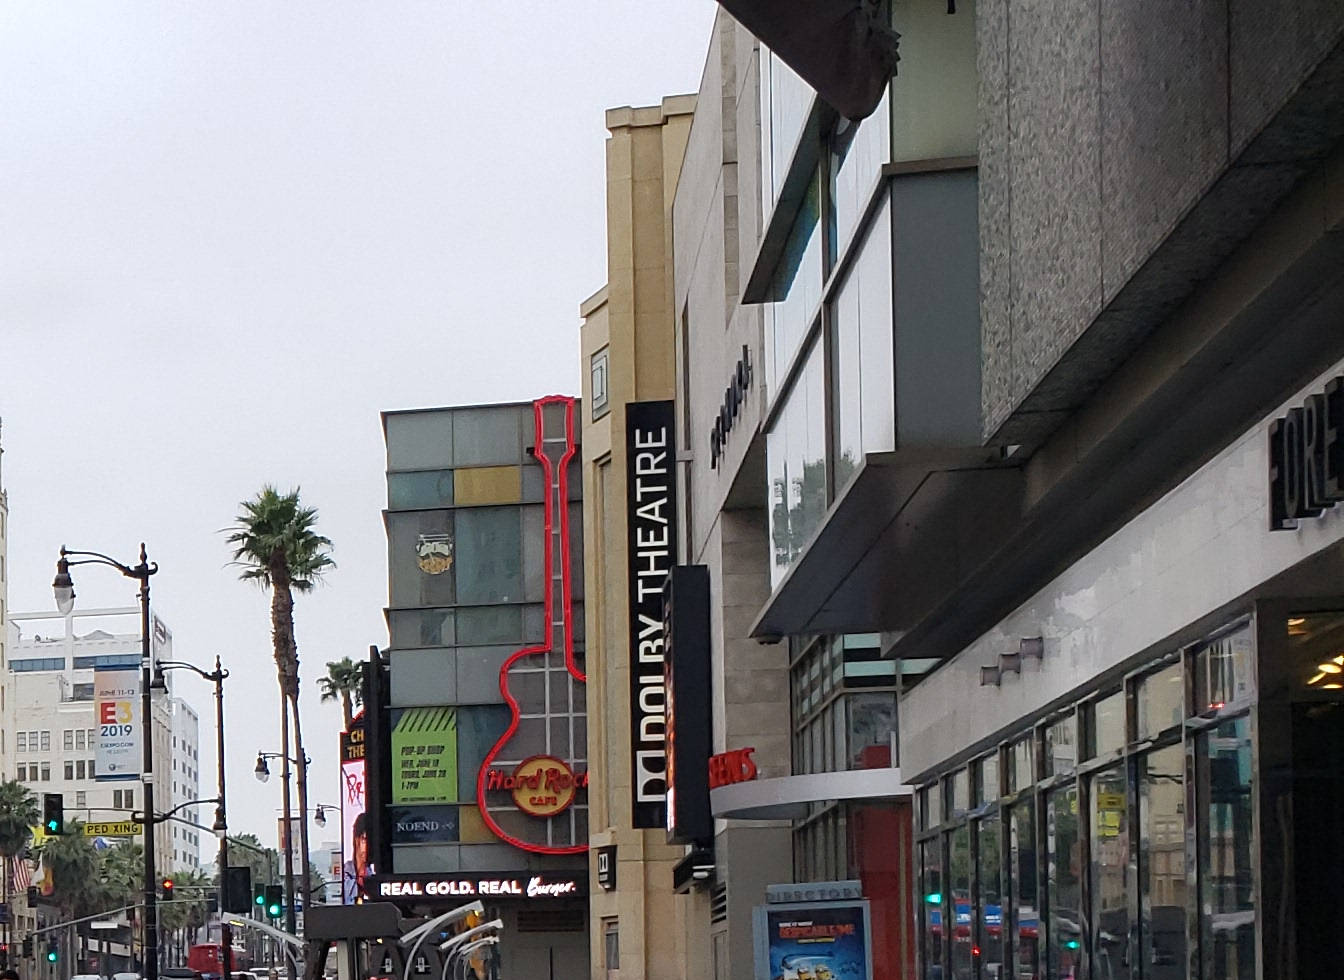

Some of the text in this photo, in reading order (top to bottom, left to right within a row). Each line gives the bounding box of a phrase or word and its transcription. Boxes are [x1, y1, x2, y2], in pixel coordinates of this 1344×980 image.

[636, 428, 668, 603] THEATRE
[101, 702, 133, 724] E3
[100, 725, 132, 737] 2019
[487, 769, 543, 792] Hard
[529, 796, 558, 806] CAFE
[87, 822, 138, 835] PED XING
[397, 822, 439, 832] NOEND
[381, 876, 576, 897] REAL GOLD. REAL Burger.
[765, 887, 861, 901] DIRECTORY
